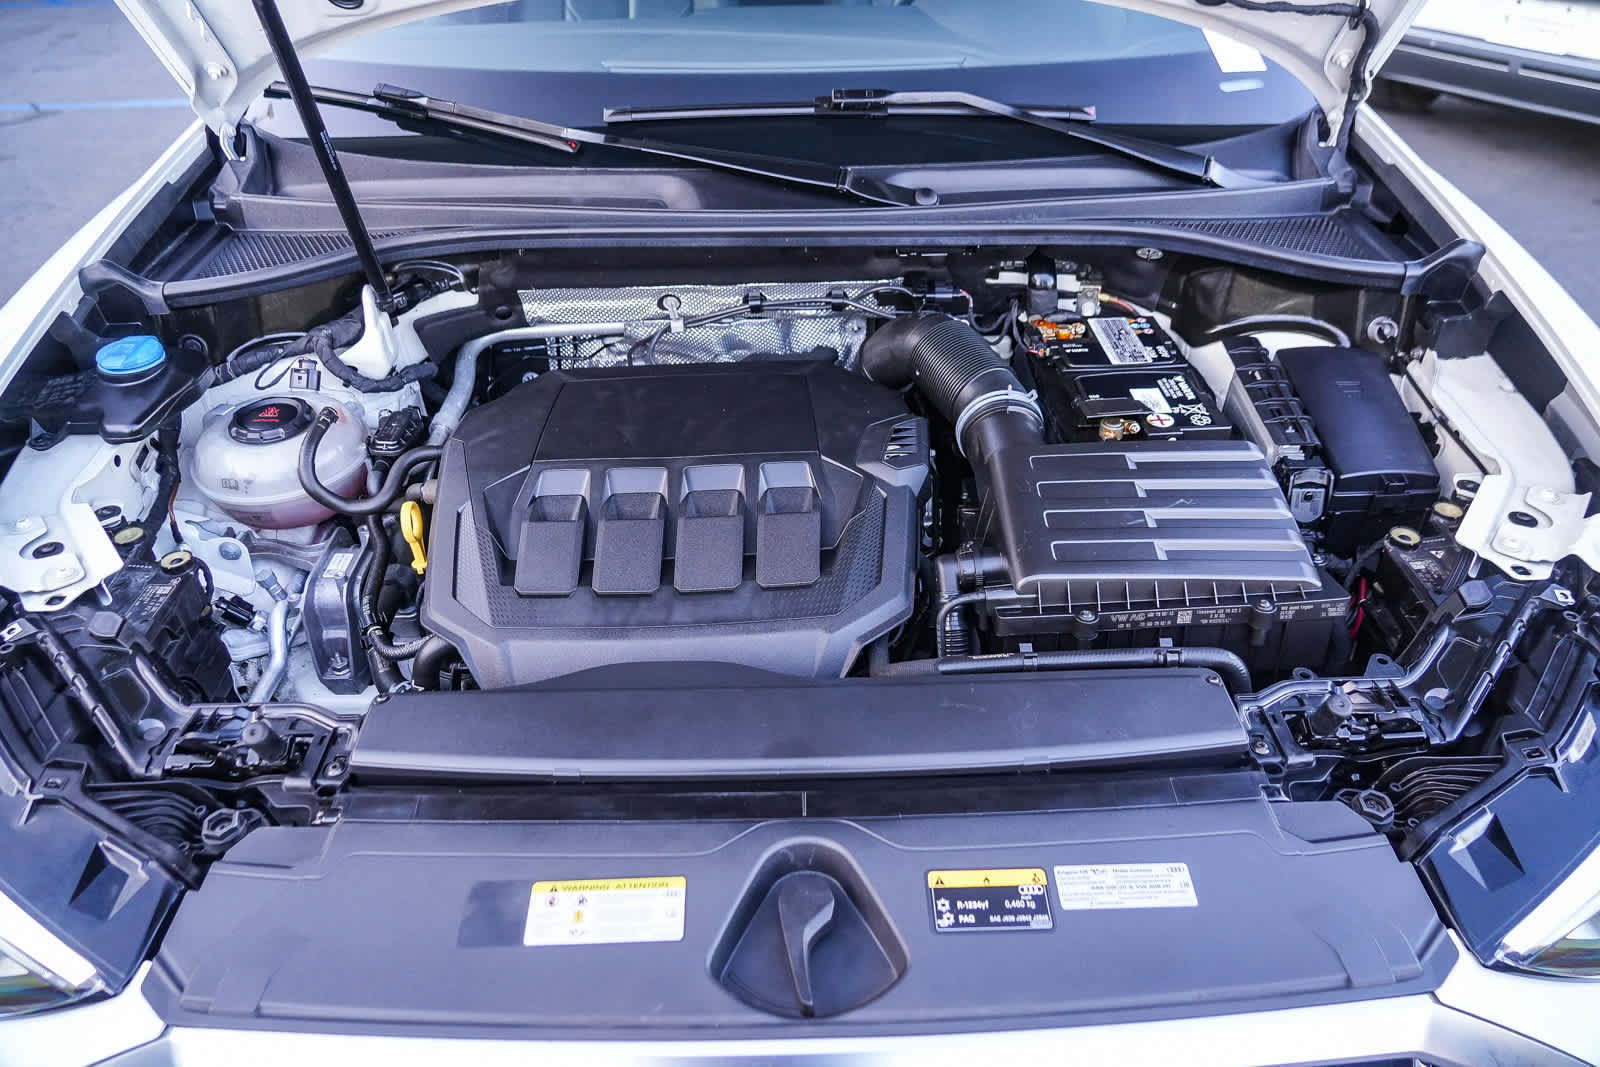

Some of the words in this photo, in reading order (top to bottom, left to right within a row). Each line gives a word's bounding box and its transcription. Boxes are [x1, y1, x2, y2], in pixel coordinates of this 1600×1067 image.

[616, 880, 670, 889] ATTENTION
[957, 899, 989, 911] R-1234yf
[958, 914, 976, 924] PAG
